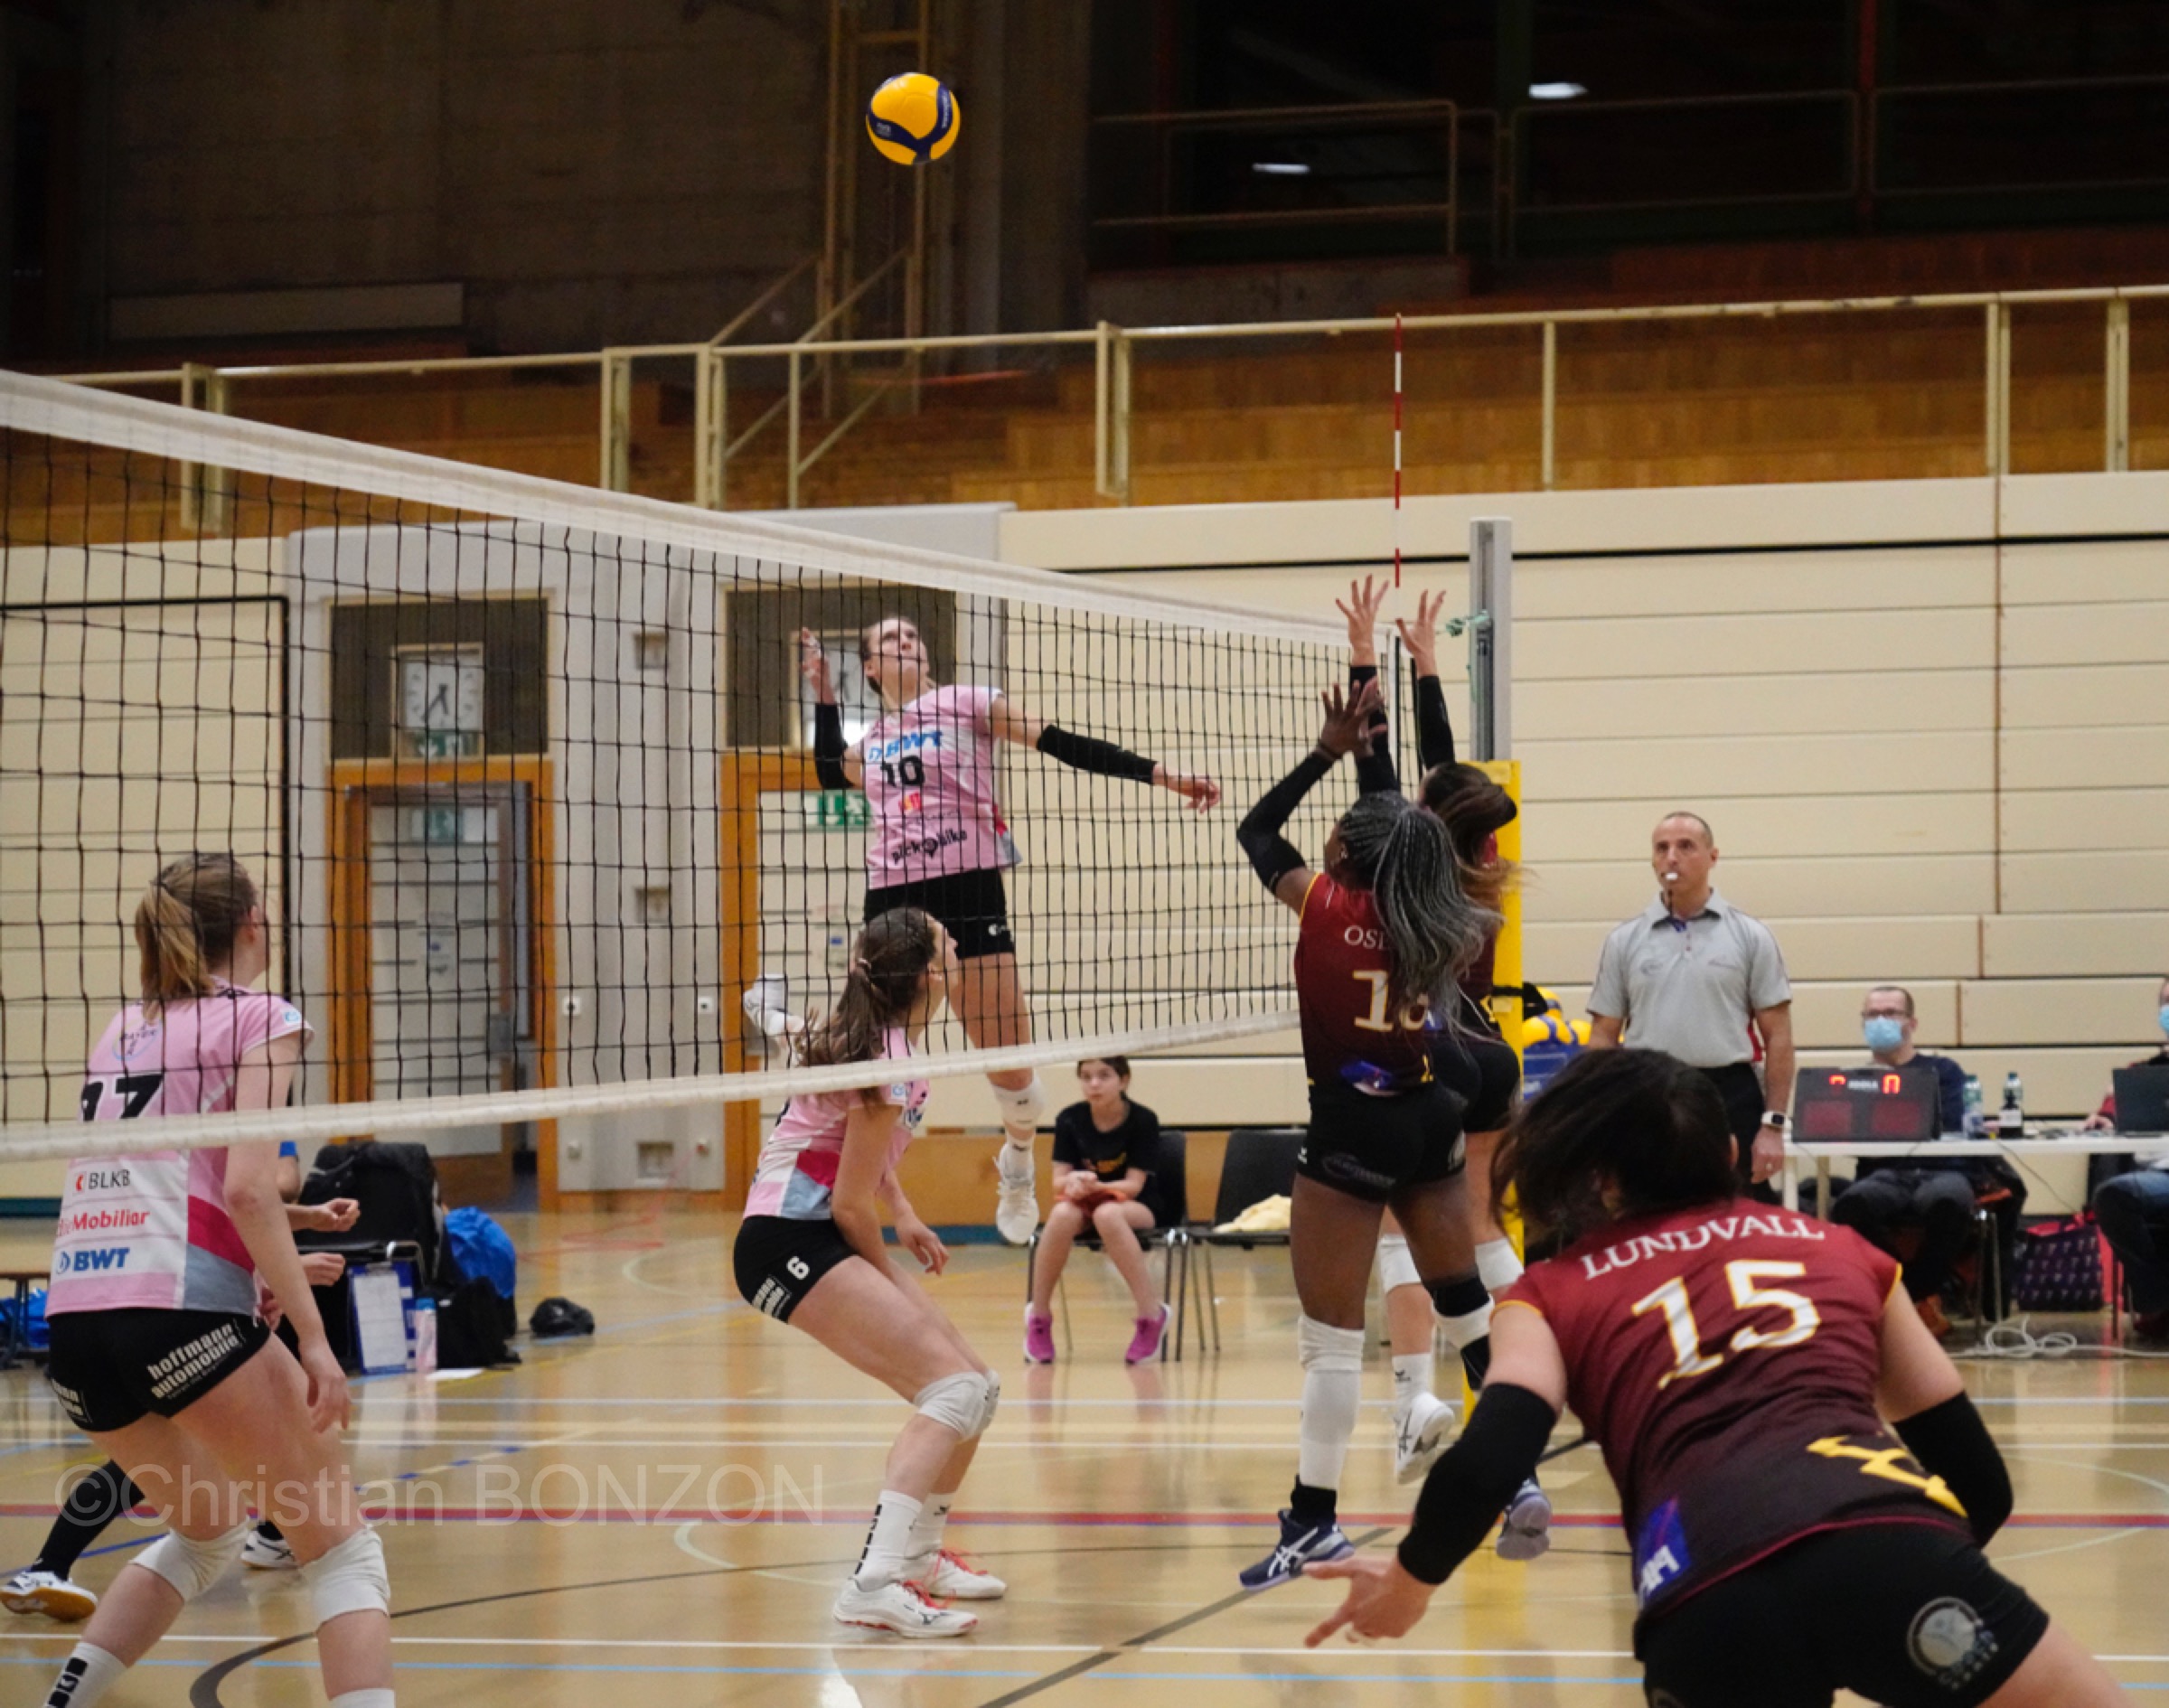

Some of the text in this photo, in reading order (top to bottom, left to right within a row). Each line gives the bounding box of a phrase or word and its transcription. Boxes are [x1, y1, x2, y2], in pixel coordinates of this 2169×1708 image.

[881, 755, 925, 788] 10
[88, 1168, 131, 1190] BLKB
[72, 1247, 131, 1272] BWT
[1580, 1212, 1825, 1280] LUNDVALL
[786, 1255, 810, 1280] 6
[1630, 1259, 1822, 1389] 15
[146, 1323, 234, 1380] hoffmann
